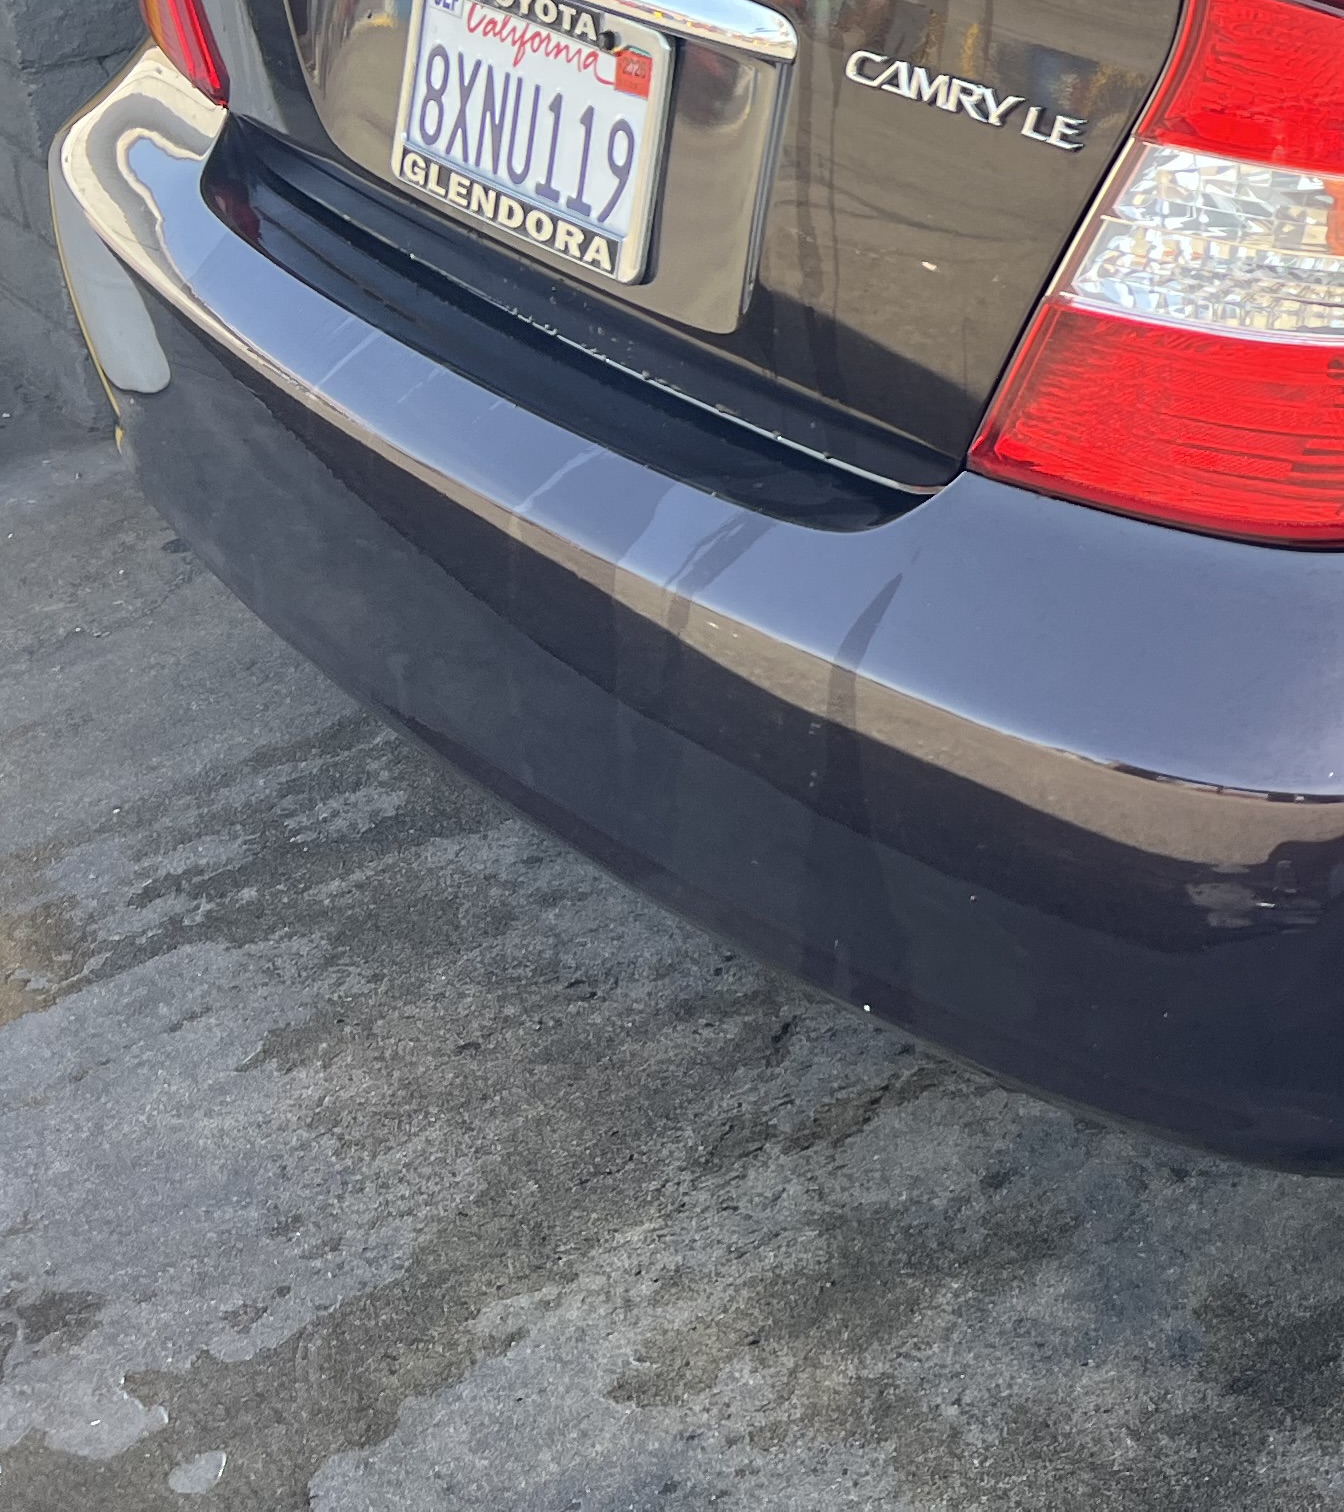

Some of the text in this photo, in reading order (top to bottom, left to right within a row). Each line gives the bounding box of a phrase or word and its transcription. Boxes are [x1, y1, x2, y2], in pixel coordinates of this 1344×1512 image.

[466, 2, 616, 88] California
[845, 49, 1088, 153] CAMRY LE
[418, 42, 636, 224] 8XNU119
[402, 151, 614, 272] GLENDORA
